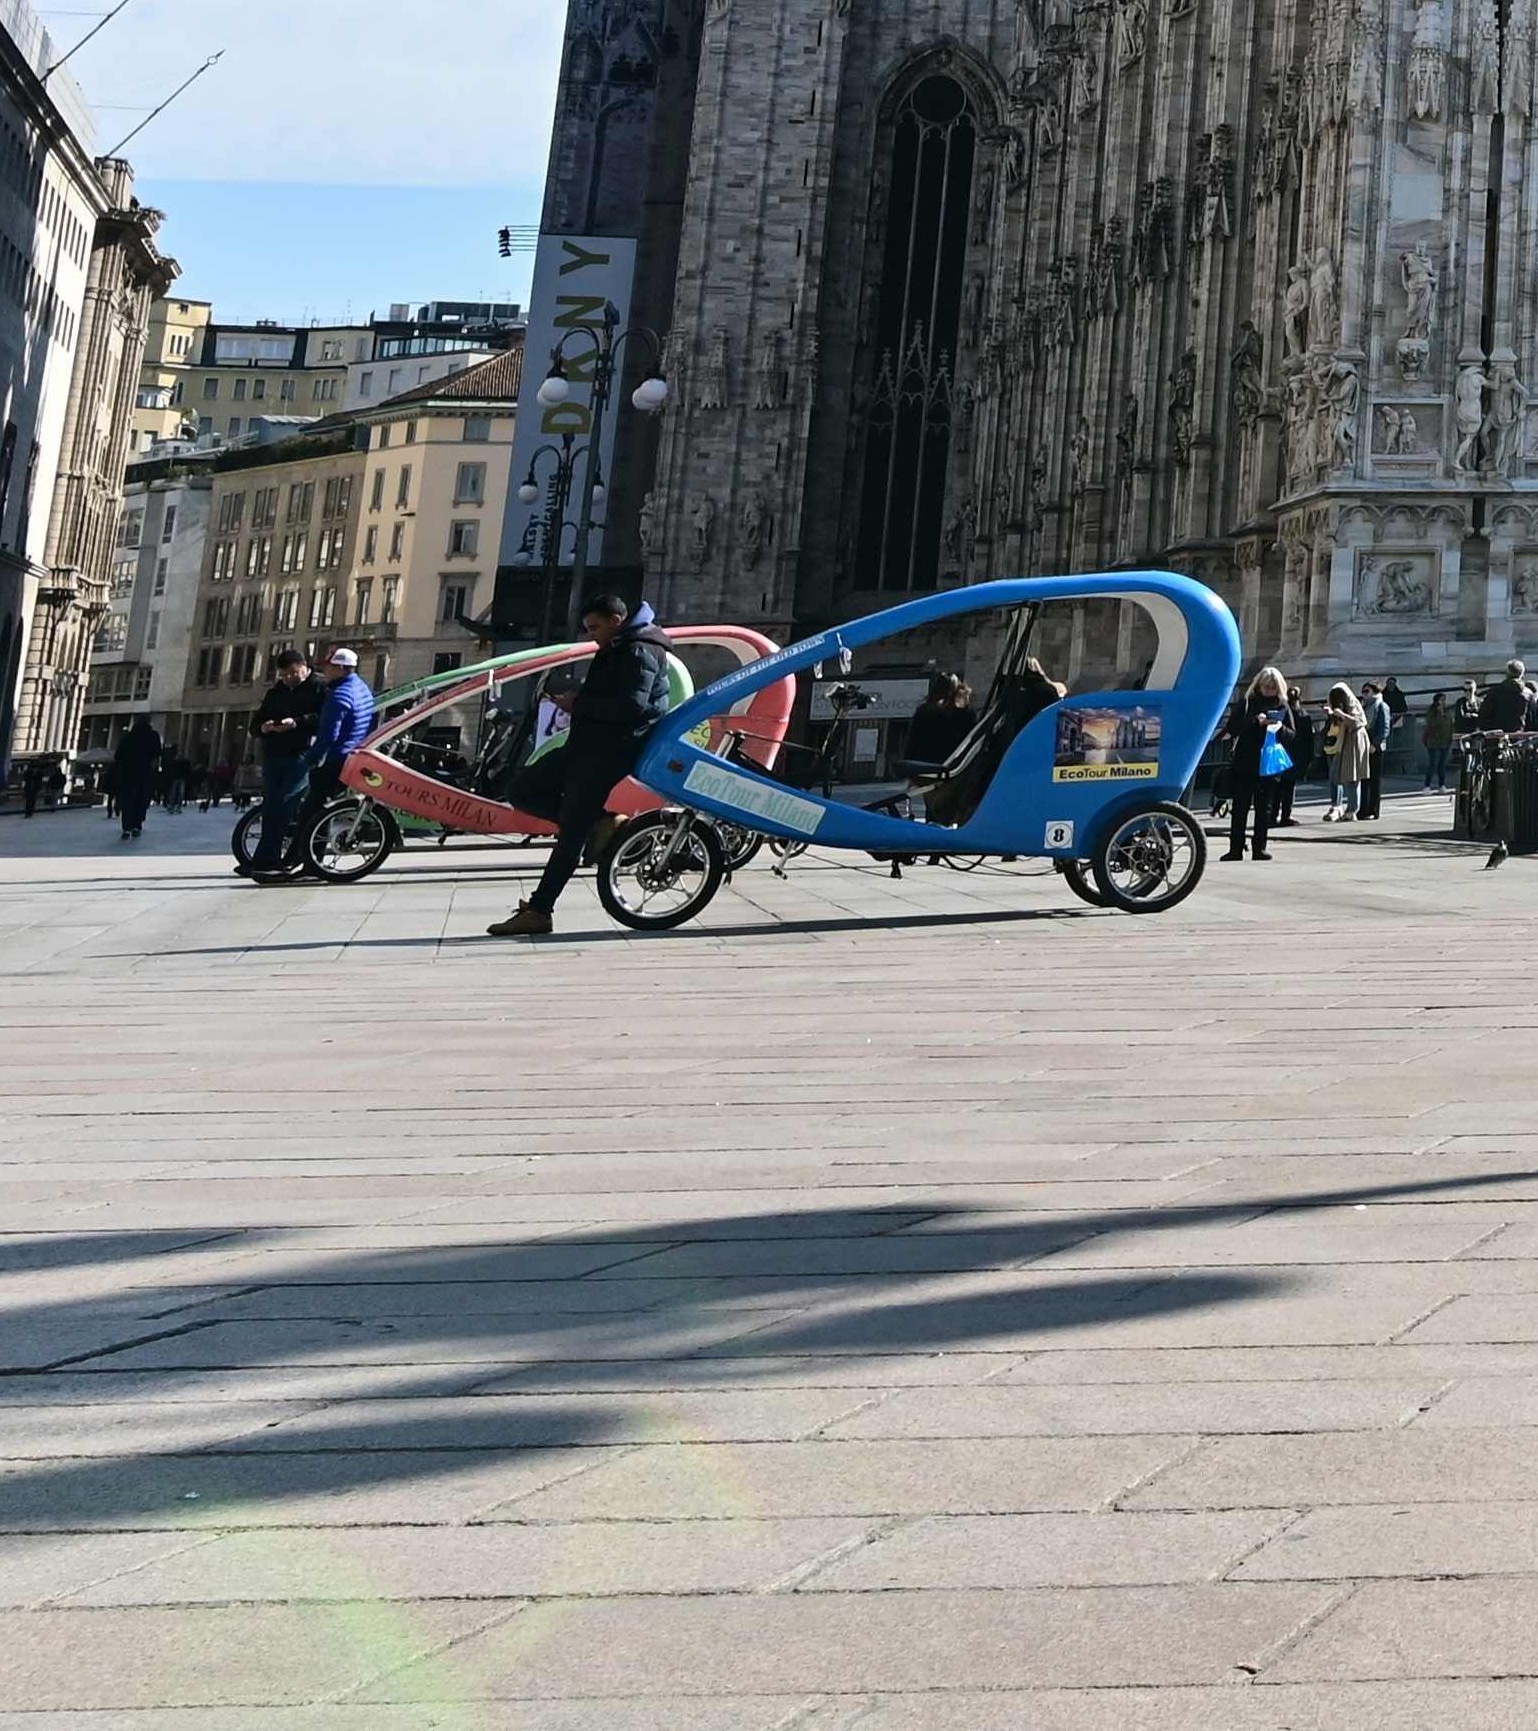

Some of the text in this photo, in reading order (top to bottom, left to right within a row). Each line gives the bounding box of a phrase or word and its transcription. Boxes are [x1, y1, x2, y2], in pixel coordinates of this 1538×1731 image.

[540, 240, 610, 434] DKNY
[1059, 767, 1152, 779] EcoTour Milano
[386, 779, 438, 806] TOURS
[443, 796, 498, 827] MILAN
[1053, 828, 1065, 842] 8
